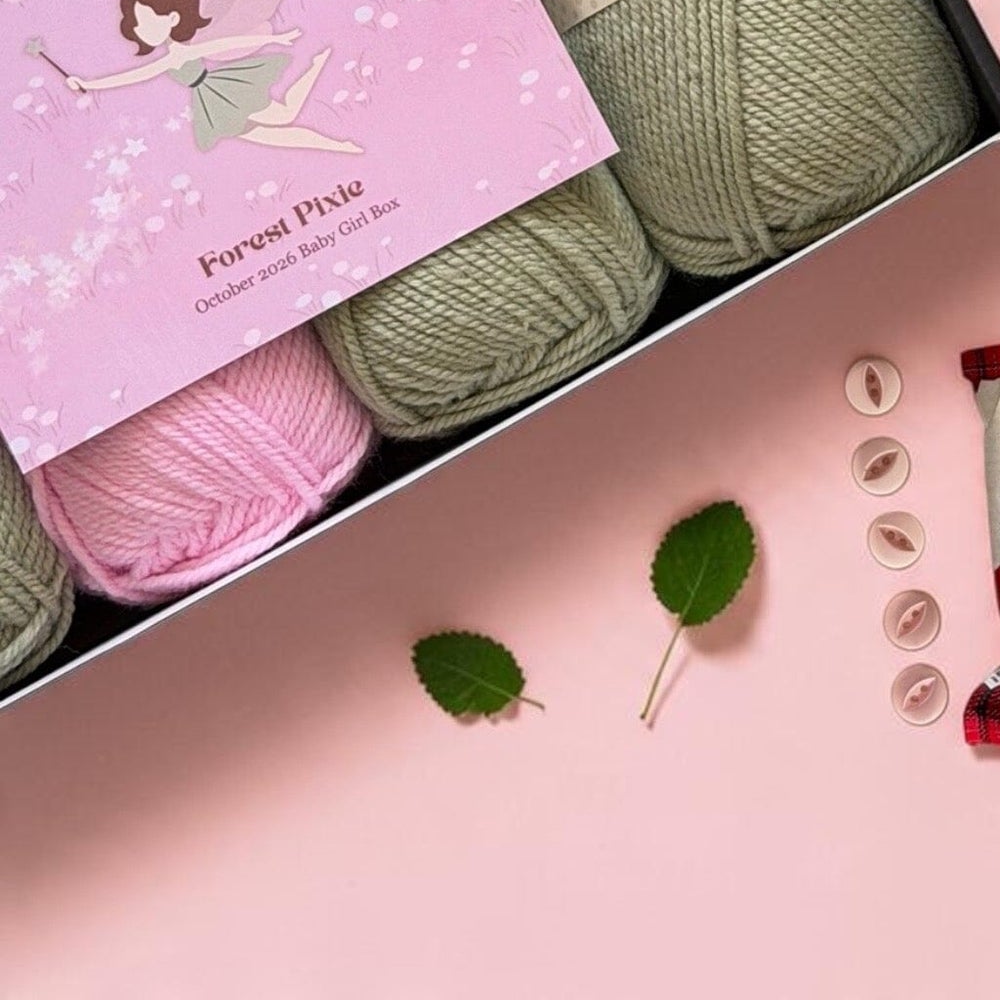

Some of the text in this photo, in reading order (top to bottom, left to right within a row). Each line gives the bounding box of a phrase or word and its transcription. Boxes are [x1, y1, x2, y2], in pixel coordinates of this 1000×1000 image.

[195, 197, 401, 314] October 2026 Baby Girl Box
[197, 180, 365, 278] Forest Pixie
